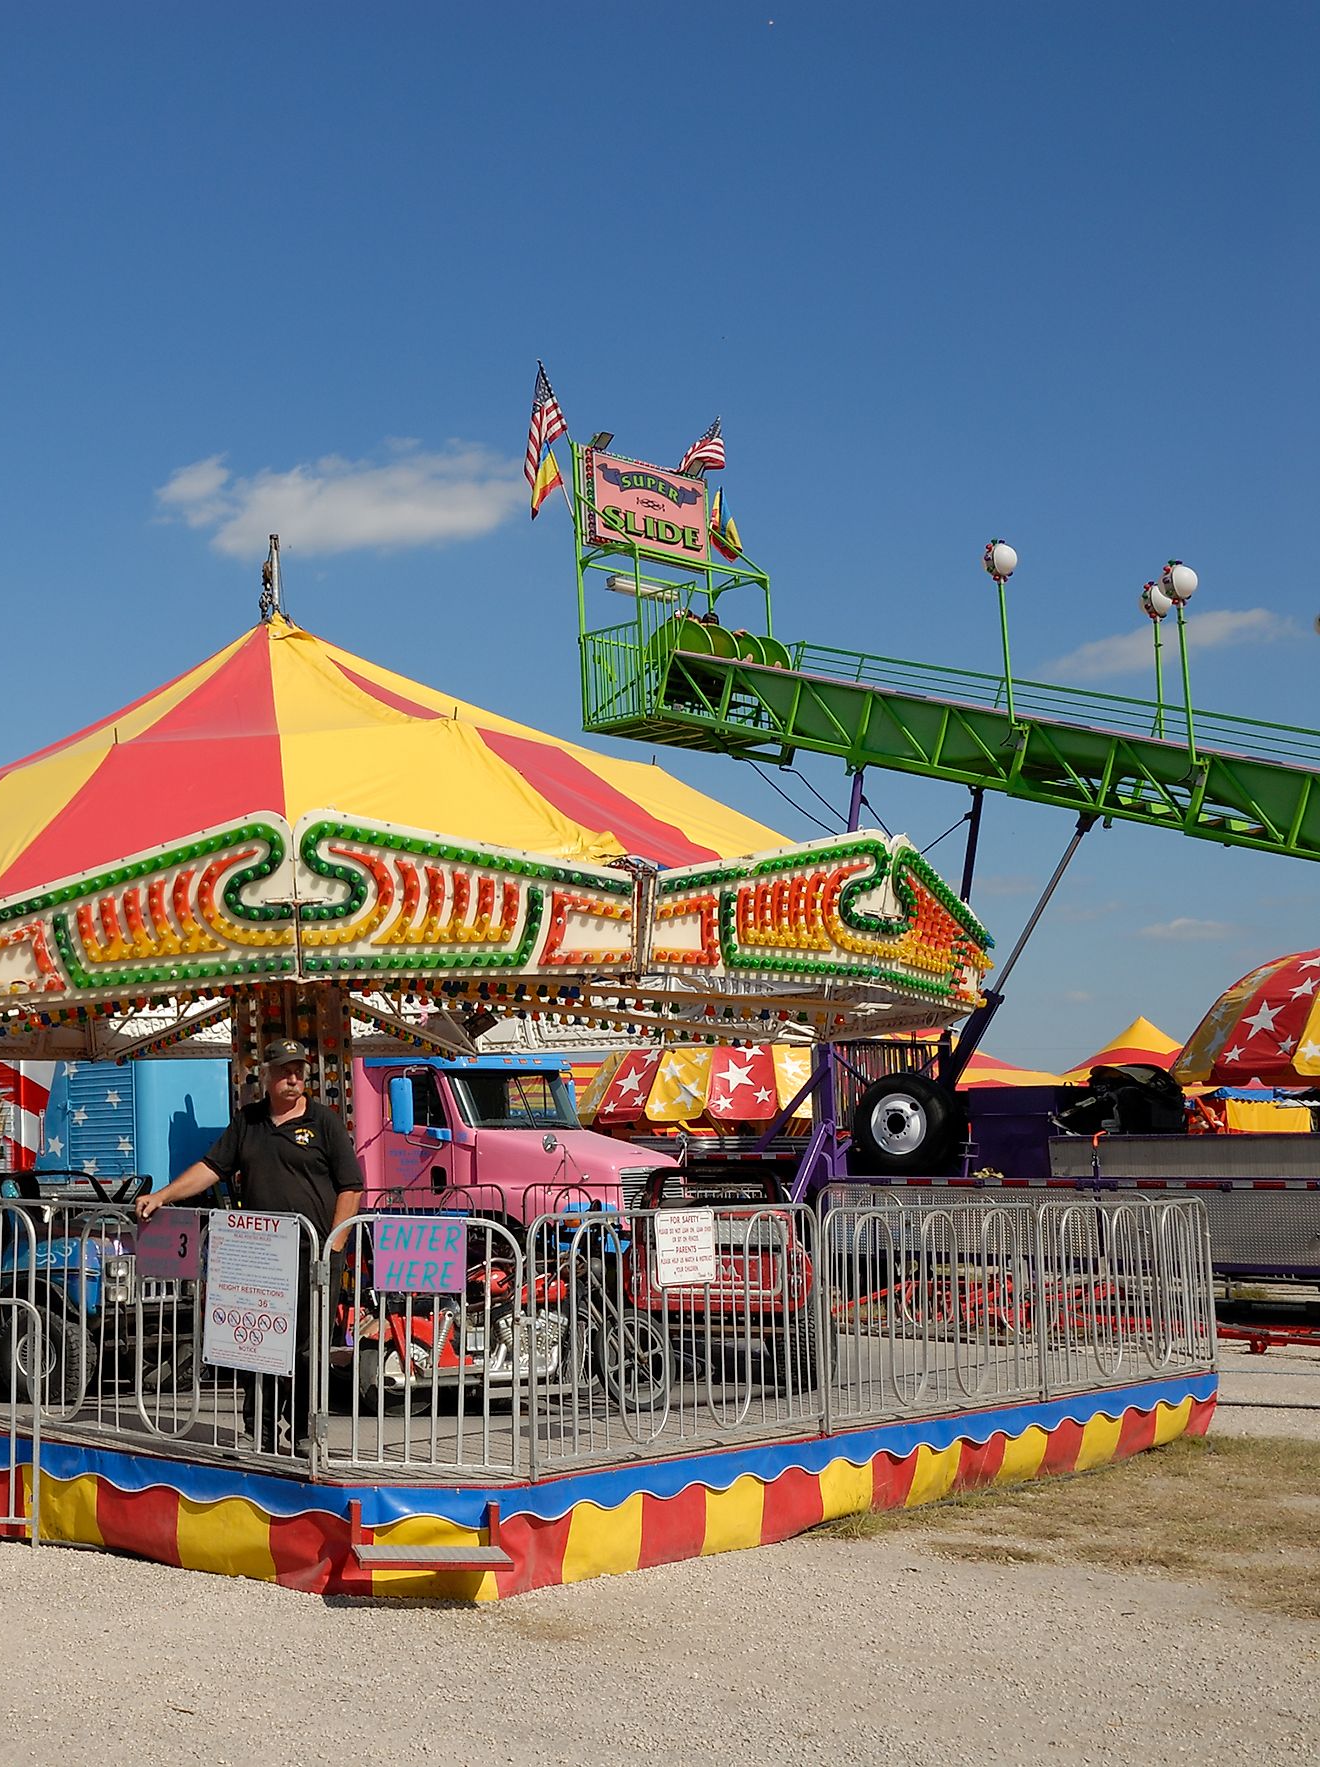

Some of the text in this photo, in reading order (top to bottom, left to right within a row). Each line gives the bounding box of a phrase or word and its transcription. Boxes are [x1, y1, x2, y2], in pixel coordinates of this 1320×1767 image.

[620, 474, 680, 503] SUPER
[601, 504, 704, 552] SLIDE
[227, 1213, 280, 1233] SAFETY
[670, 1215, 699, 1224] FOR SAFETY
[178, 1233, 188, 1258] 3
[379, 1224, 462, 1252] ENTER
[676, 1245, 697, 1253] PARENTS
[385, 1261, 456, 1289] HERE
[241, 1285, 284, 1297] RESTRICTIONS
[258, 1299, 268, 1308] 36
